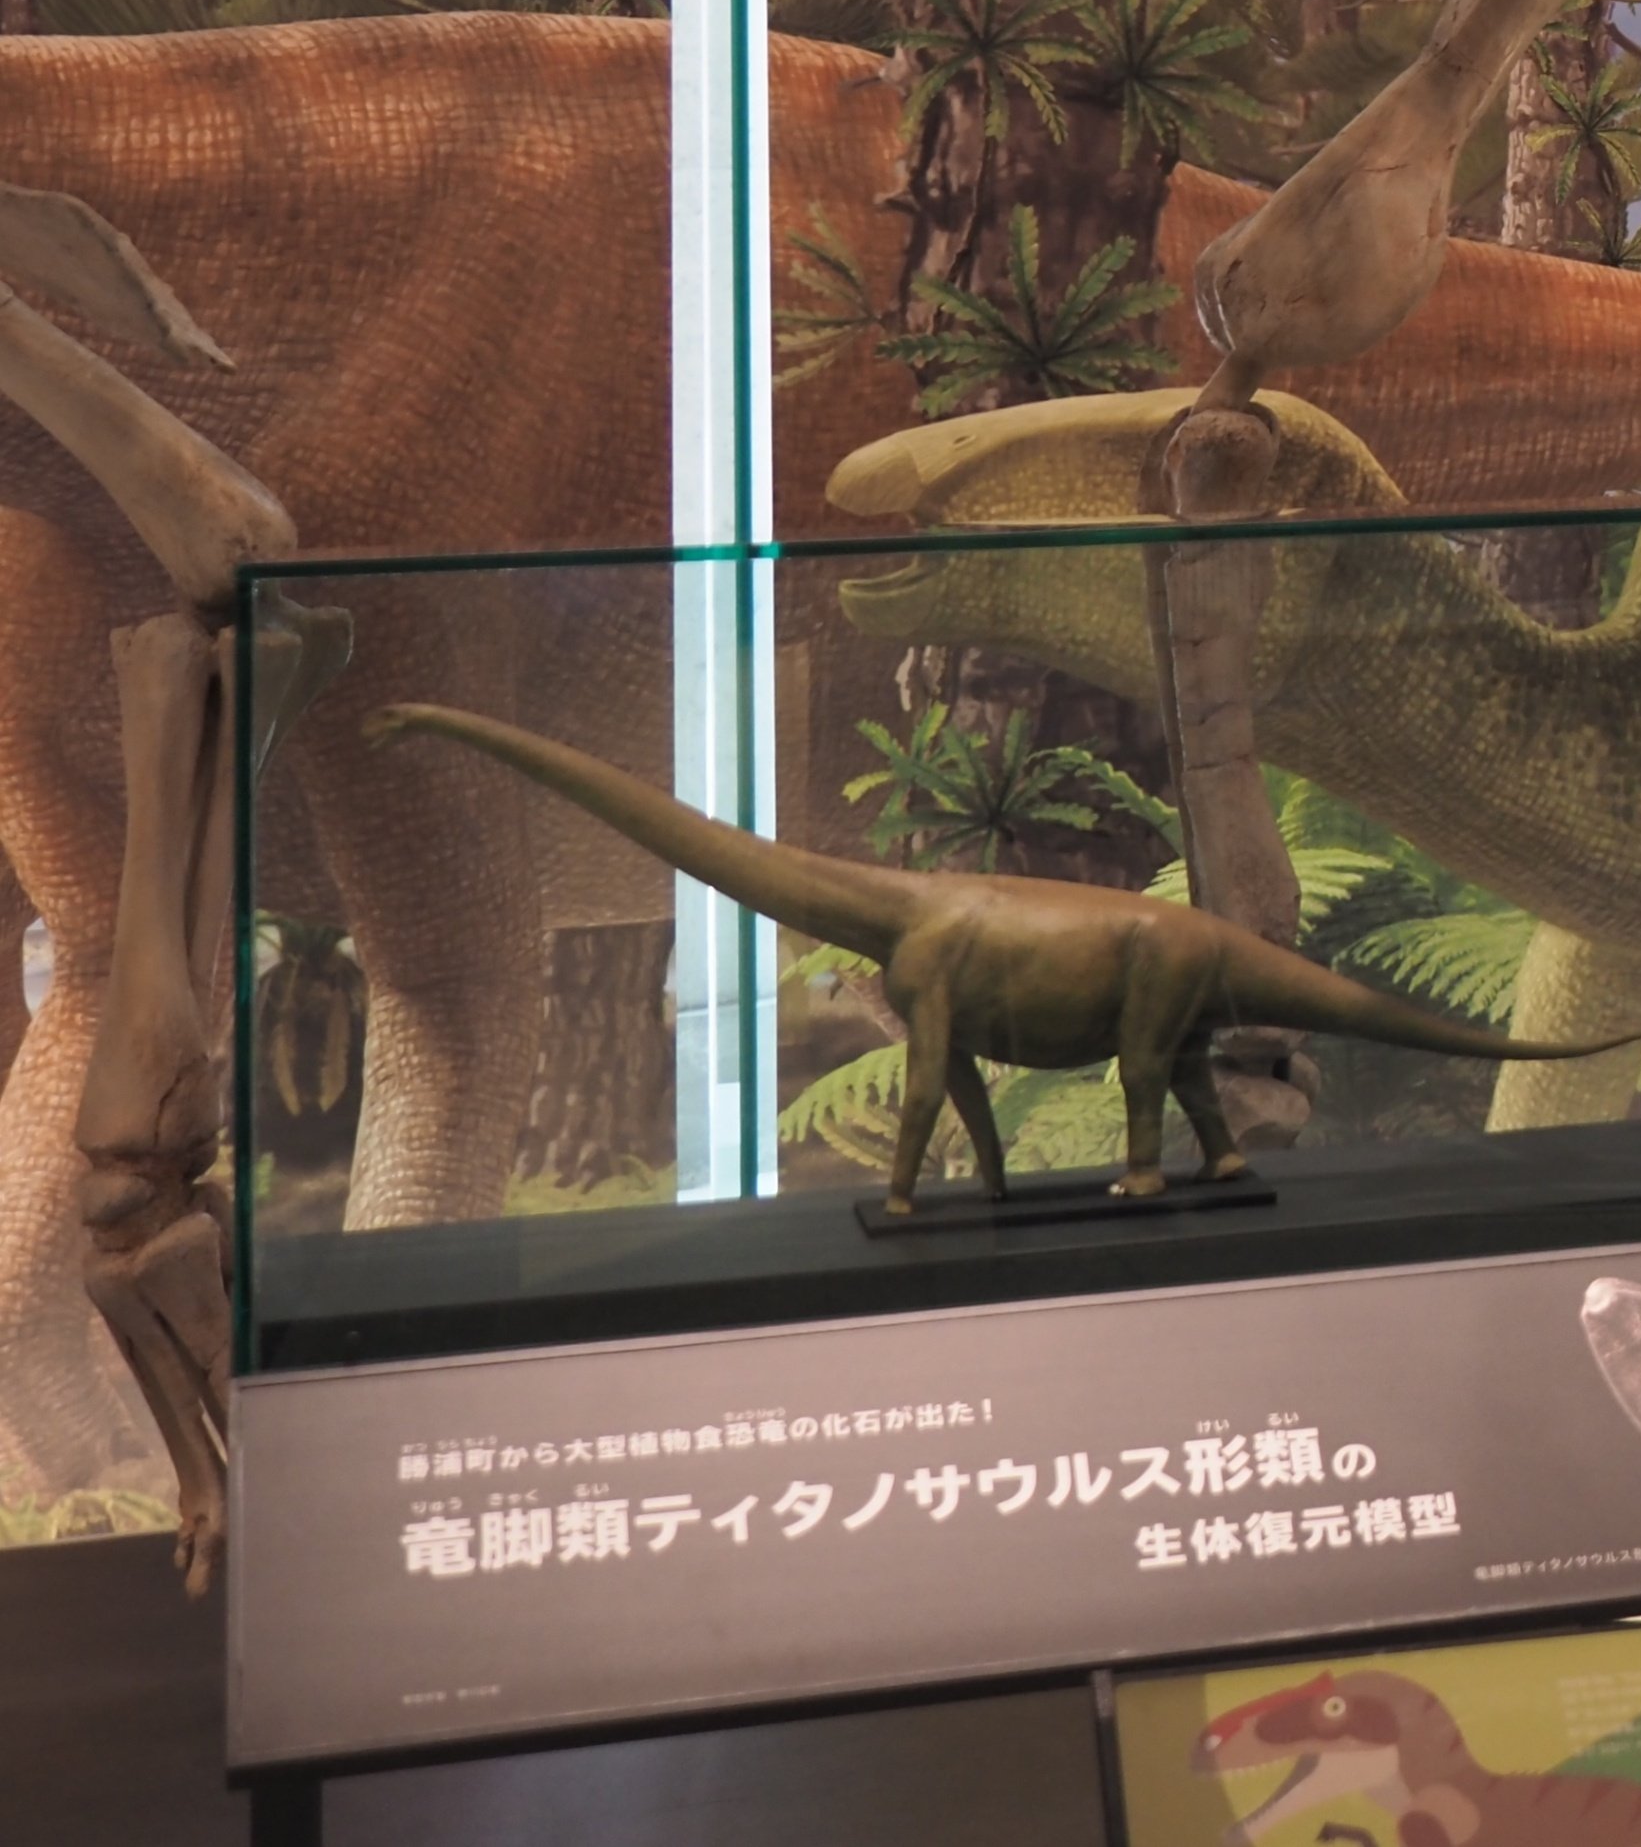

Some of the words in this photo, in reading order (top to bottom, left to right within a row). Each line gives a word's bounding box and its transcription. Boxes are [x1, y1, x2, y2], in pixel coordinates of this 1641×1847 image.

[400, 1398, 993, 1480] 勝浦町から大型植物食恐竜の化石が出た！
[401, 1427, 1376, 1577] 竜脚類ティタノサウルス形類の
[1135, 1491, 1461, 1570] 生体復元模型
